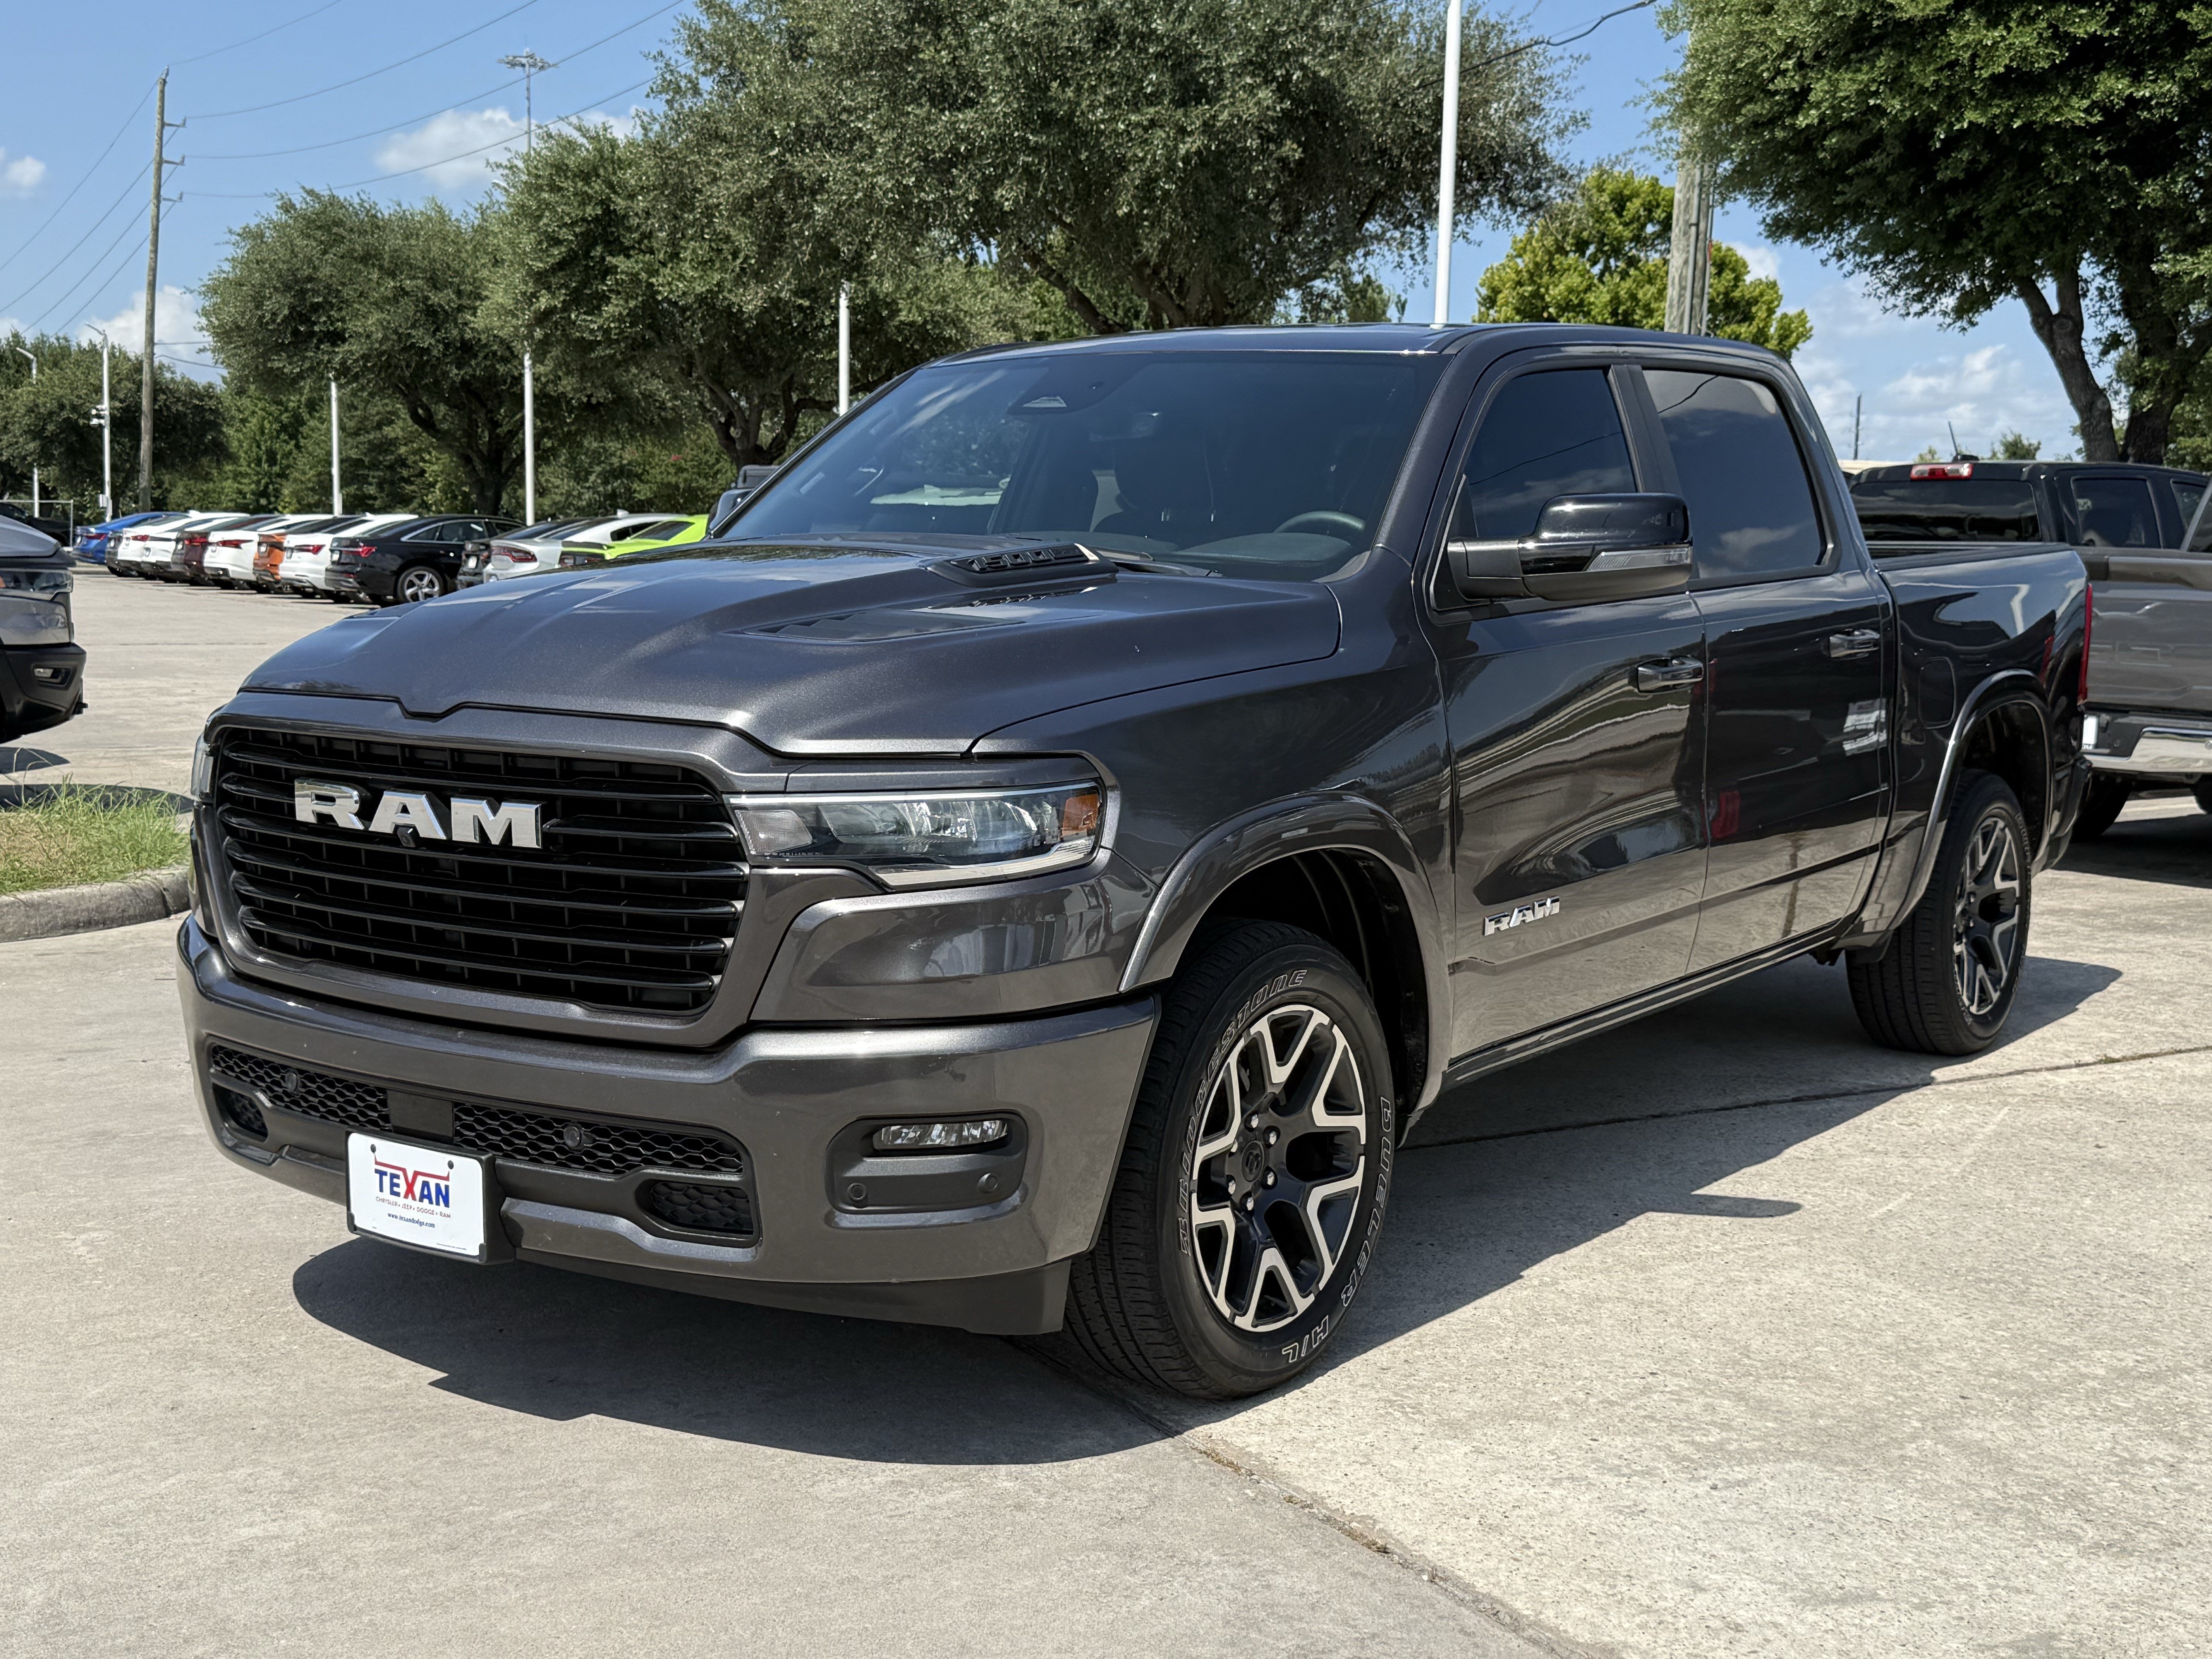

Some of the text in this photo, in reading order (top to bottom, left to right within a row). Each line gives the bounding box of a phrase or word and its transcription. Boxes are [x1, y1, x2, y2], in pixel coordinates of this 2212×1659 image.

[968, 549, 1053, 571] 1500
[295, 778, 542, 848] RAM
[1483, 896, 1560, 936] RAM
[1178, 970, 1307, 1257] BRIDGESTONE
[374, 1166, 450, 1208] TEXAN
[1341, 1096, 1392, 1307] DUELER
